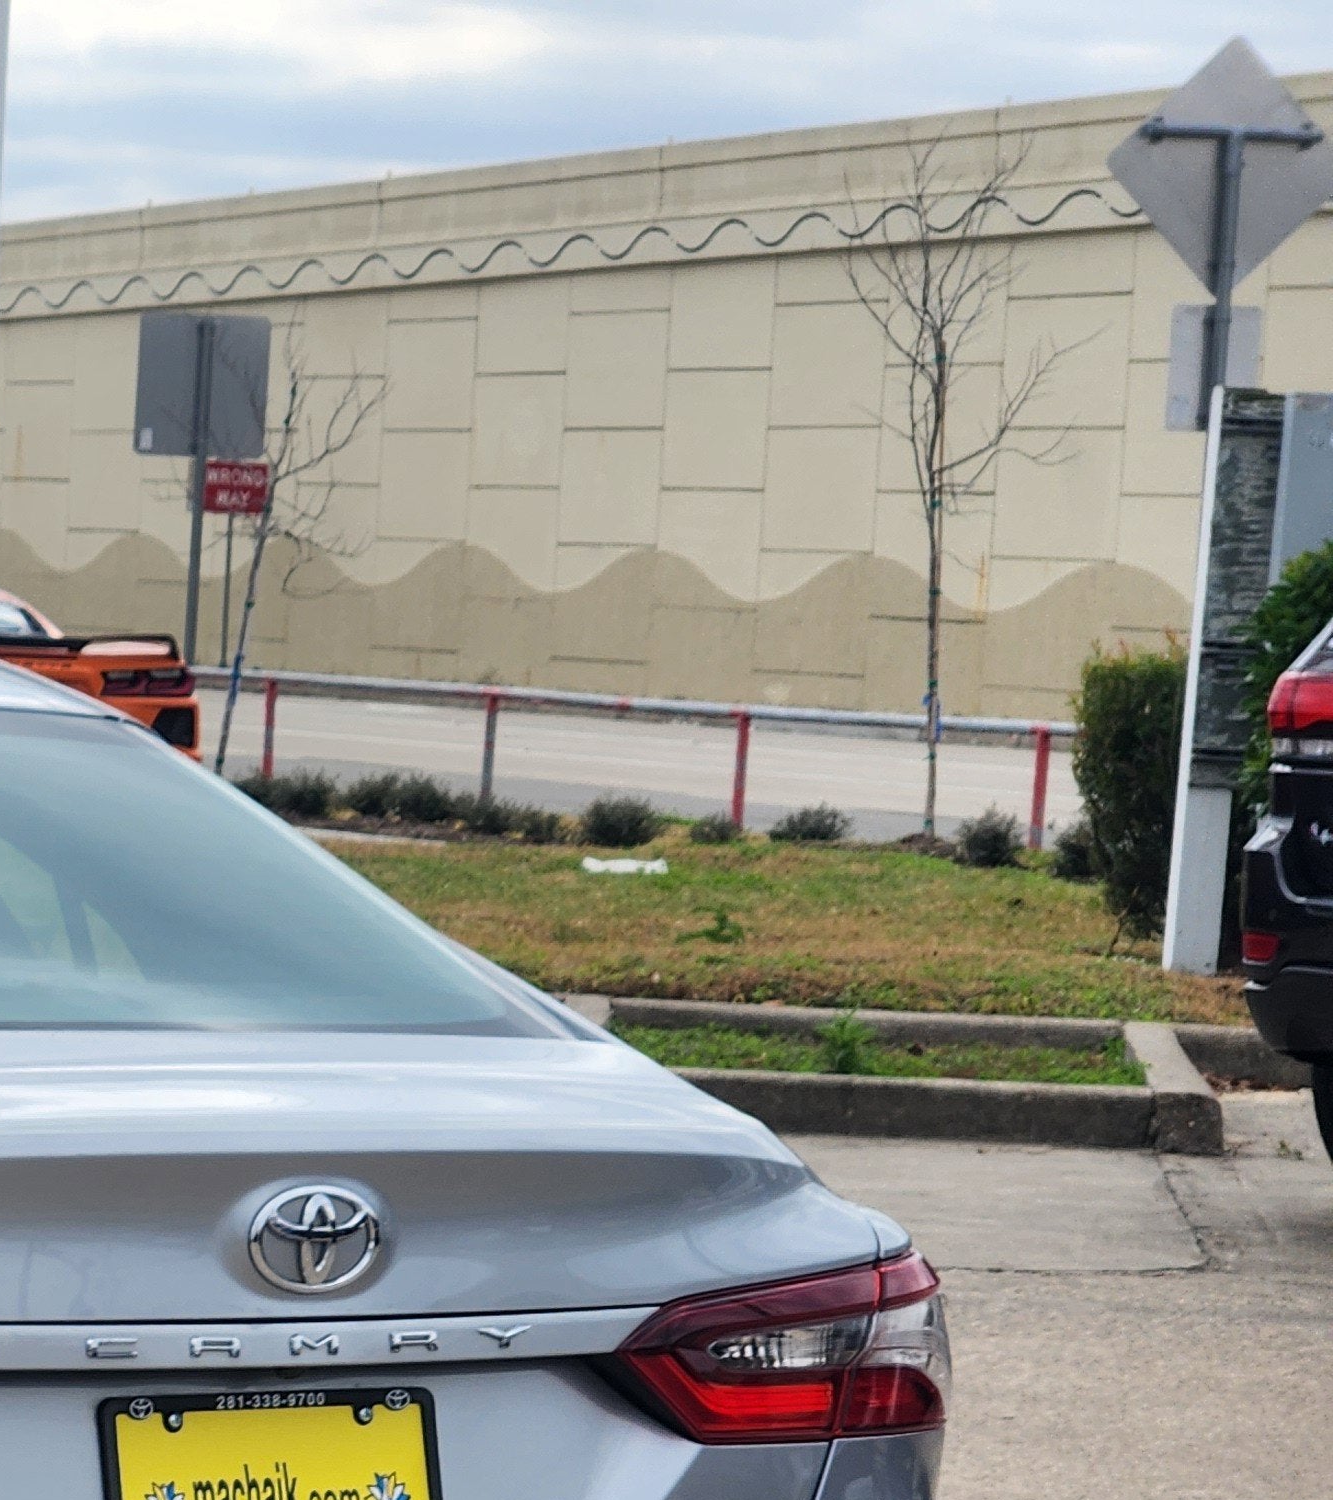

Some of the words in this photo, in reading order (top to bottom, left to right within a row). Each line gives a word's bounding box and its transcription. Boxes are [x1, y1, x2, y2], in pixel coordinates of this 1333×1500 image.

[205, 467, 265, 488] WRONG
[215, 489, 251, 508] WAY
[85, 1324, 533, 1361] CAMRY
[215, 1392, 326, 1411] 281-338-9700
